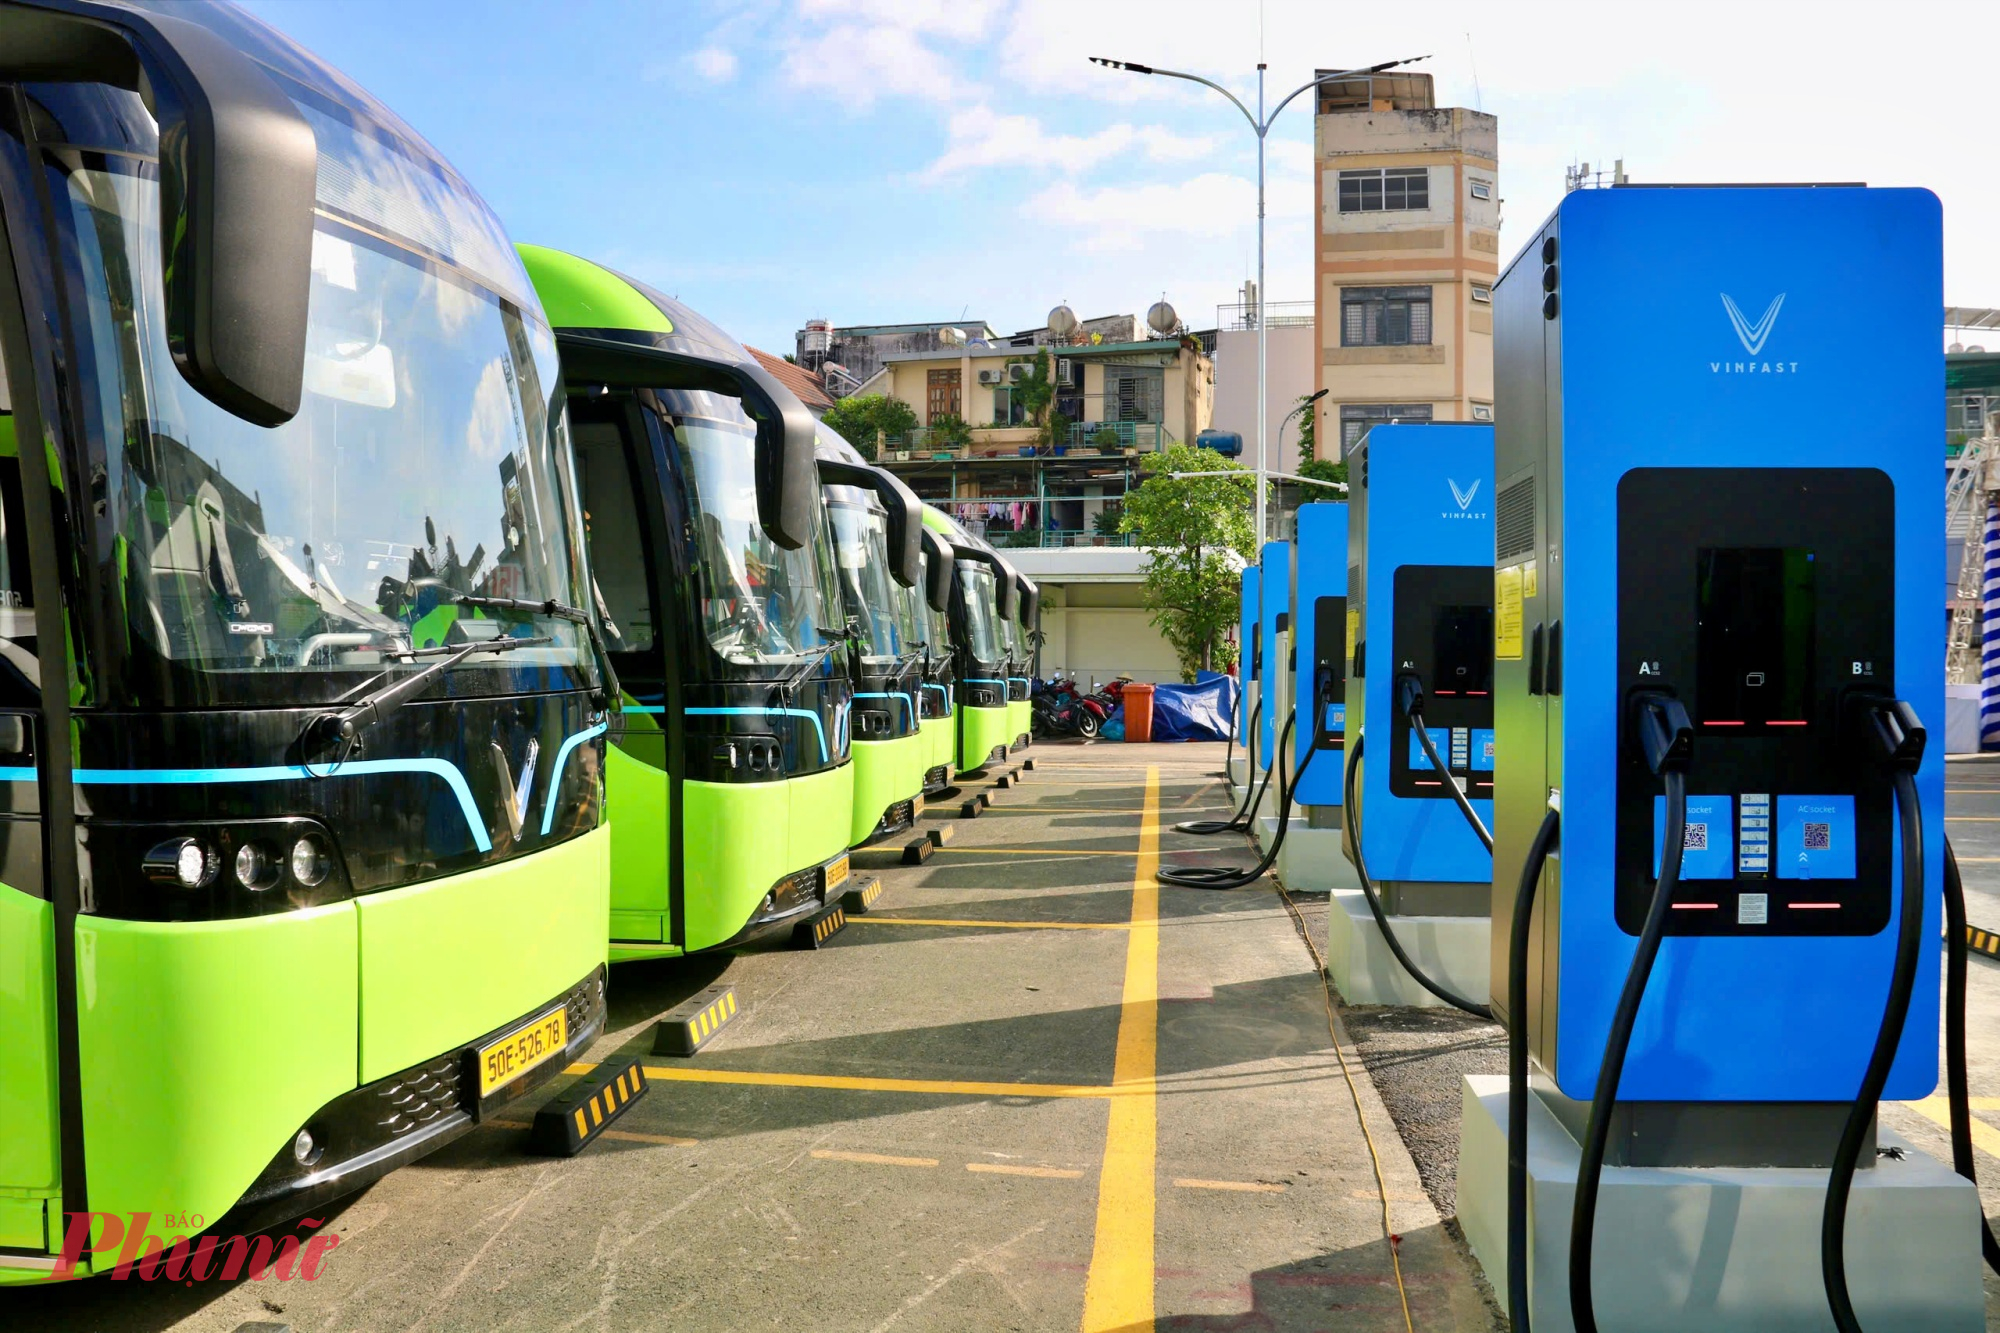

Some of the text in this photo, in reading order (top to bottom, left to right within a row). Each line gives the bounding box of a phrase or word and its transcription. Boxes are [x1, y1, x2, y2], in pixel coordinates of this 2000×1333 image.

[1710, 362, 1798, 373] VINFAST
[1639, 661, 1651, 675] A
[1852, 661, 1863, 675] B
[1687, 806, 1712, 814] socket
[1798, 805, 1836, 813] AC socket
[488, 1019, 560, 1082] 50E-526.78
